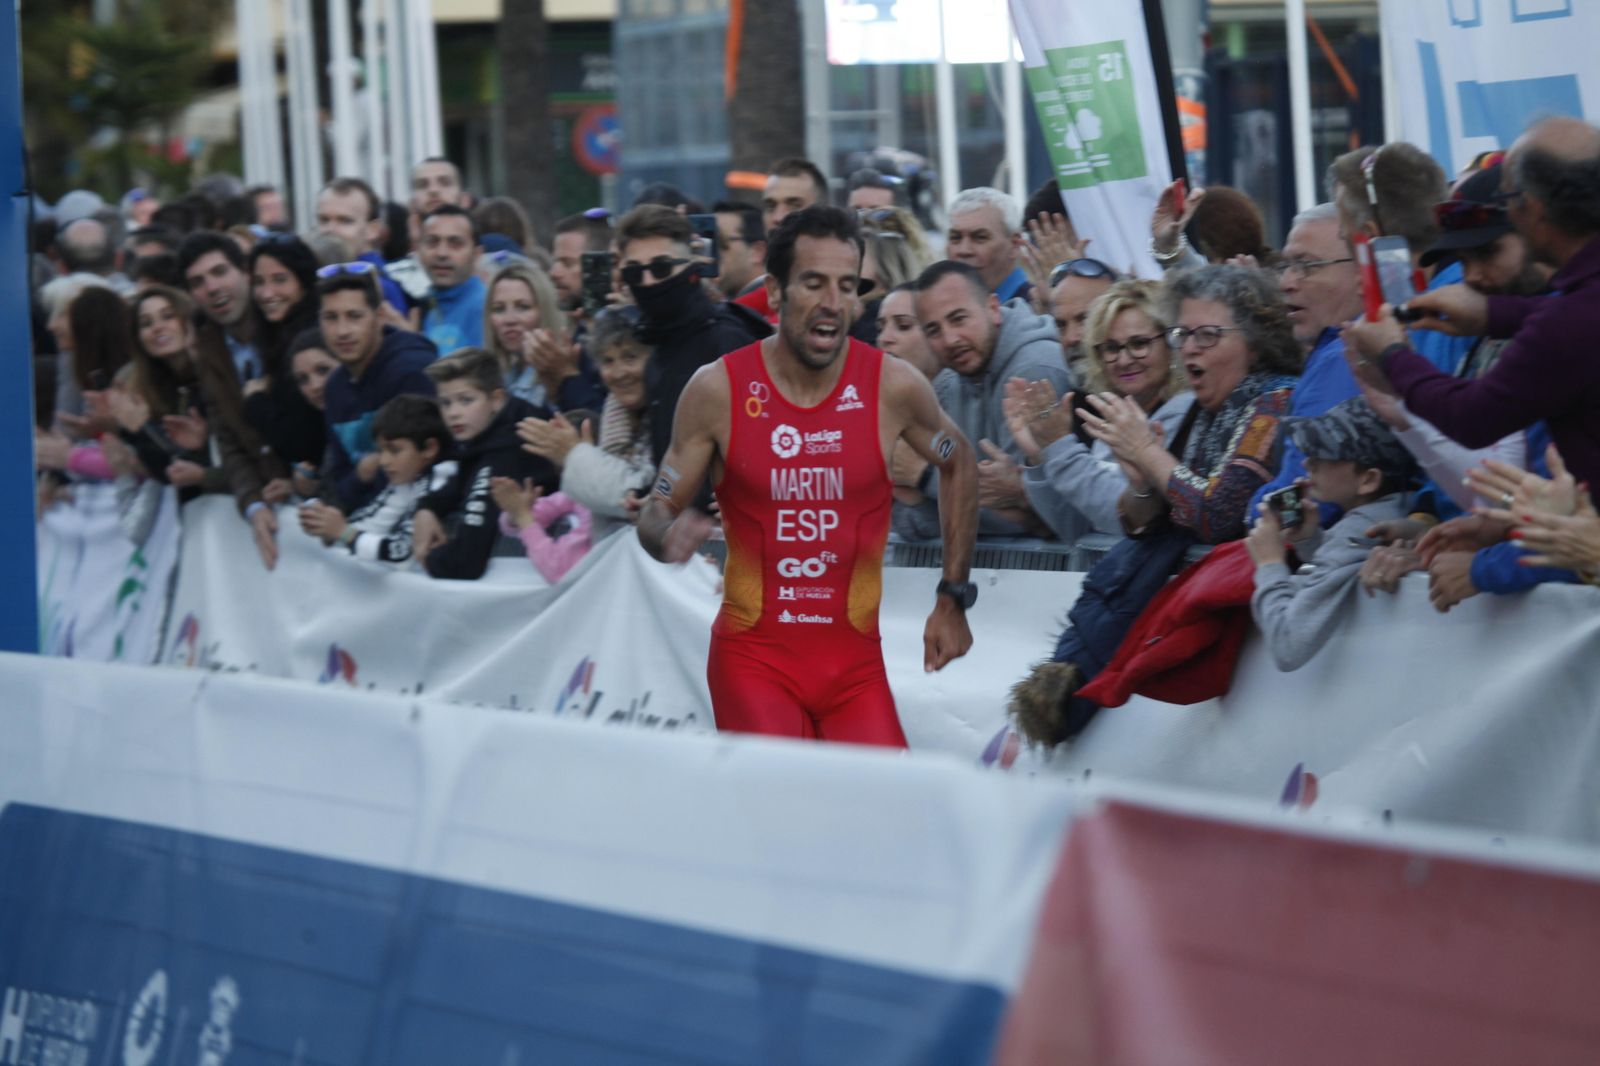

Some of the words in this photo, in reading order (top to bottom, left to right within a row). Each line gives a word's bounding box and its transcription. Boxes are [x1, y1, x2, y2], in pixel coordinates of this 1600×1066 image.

[804, 429, 842, 443] LaLiga
[804, 442, 842, 455] Sports
[770, 467, 843, 501] MARTIN
[776, 509, 839, 542] ESP
[777, 557, 827, 578] GO
